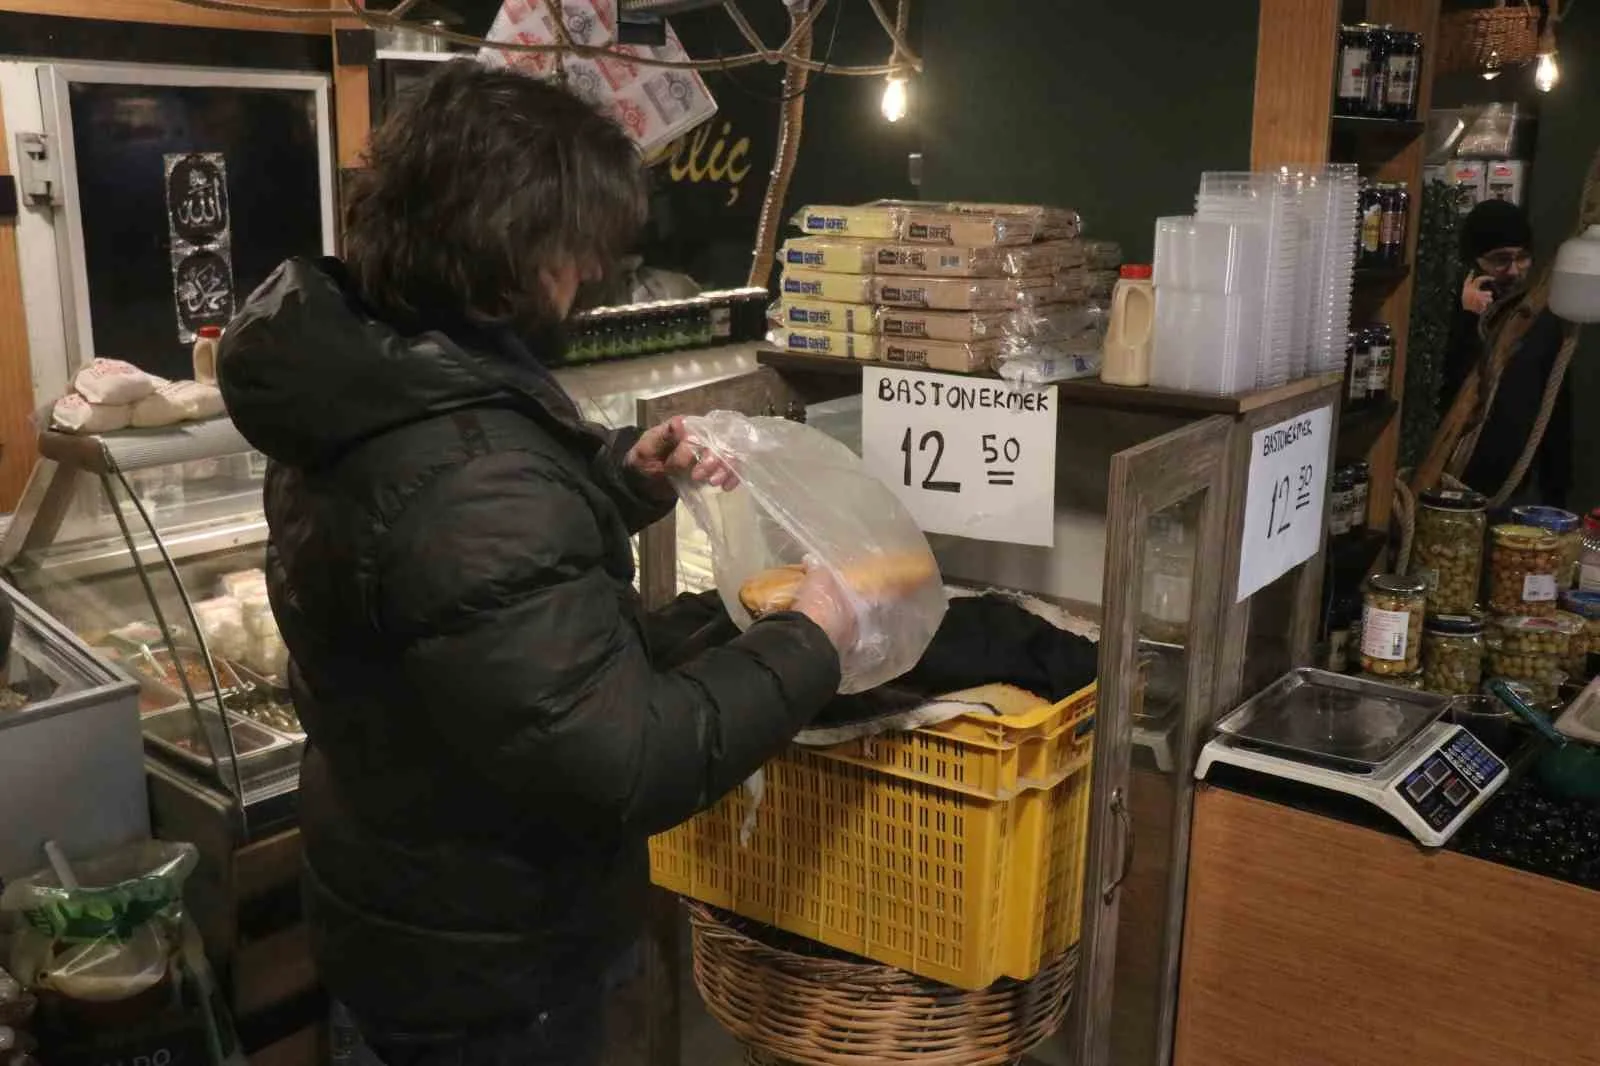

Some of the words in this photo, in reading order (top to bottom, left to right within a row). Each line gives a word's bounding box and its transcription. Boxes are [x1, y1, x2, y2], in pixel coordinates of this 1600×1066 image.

[901, 427, 961, 493] 12
[981, 433, 1021, 464] 50
[1267, 475, 1291, 539] 12
[1298, 463, 1313, 491] 50
